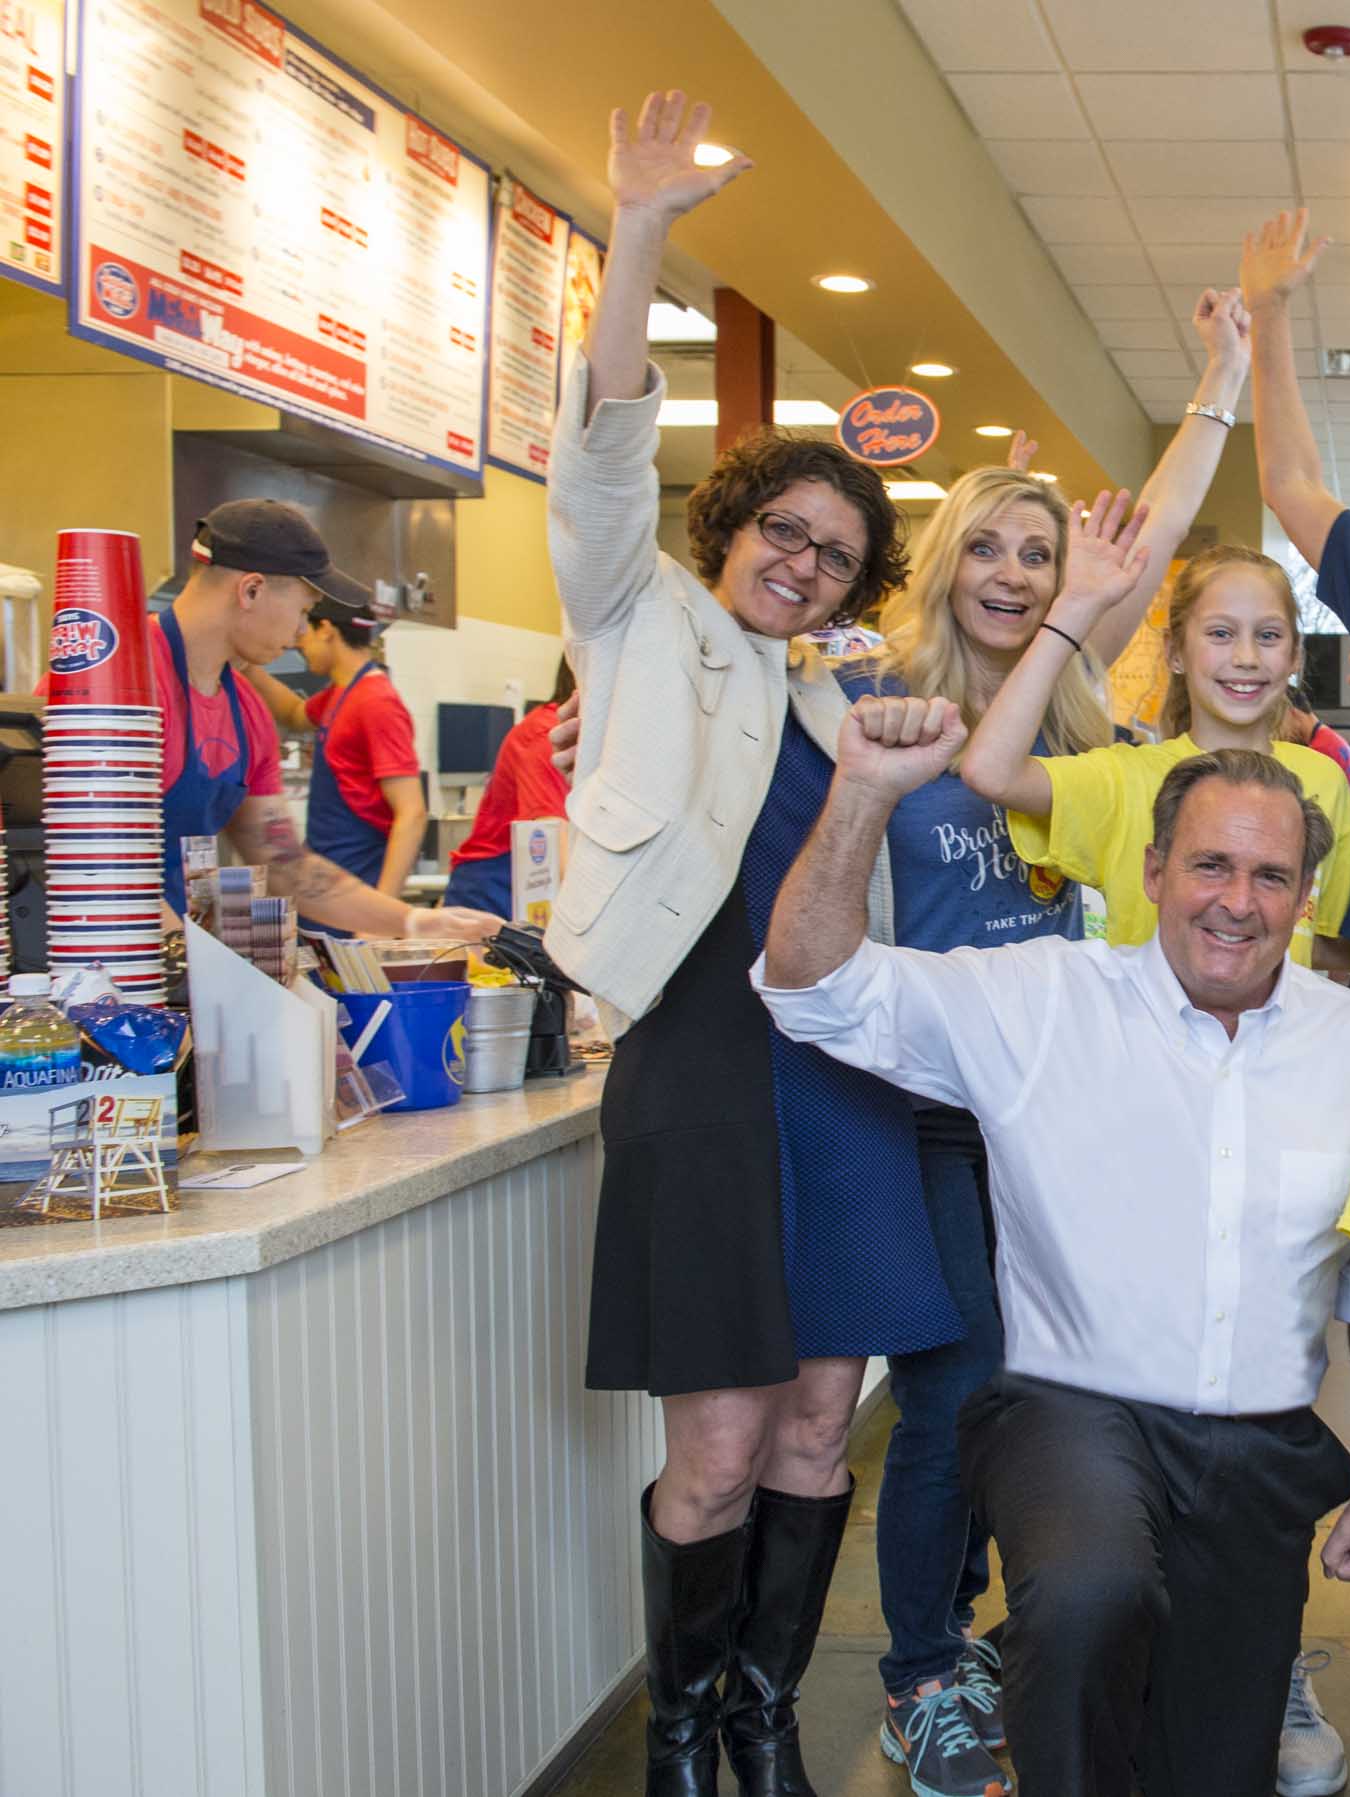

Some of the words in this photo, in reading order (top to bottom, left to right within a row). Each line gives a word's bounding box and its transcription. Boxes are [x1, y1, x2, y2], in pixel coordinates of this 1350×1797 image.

[850, 399, 922, 427] Order
[857, 427, 922, 456] Here
[930, 803, 1008, 863] Brad
[985, 917, 1016, 931] TAKE
[3, 1065, 78, 1089] AQUAFINA
[77, 1100, 89, 1122] 2
[97, 1095, 116, 1123] 2
